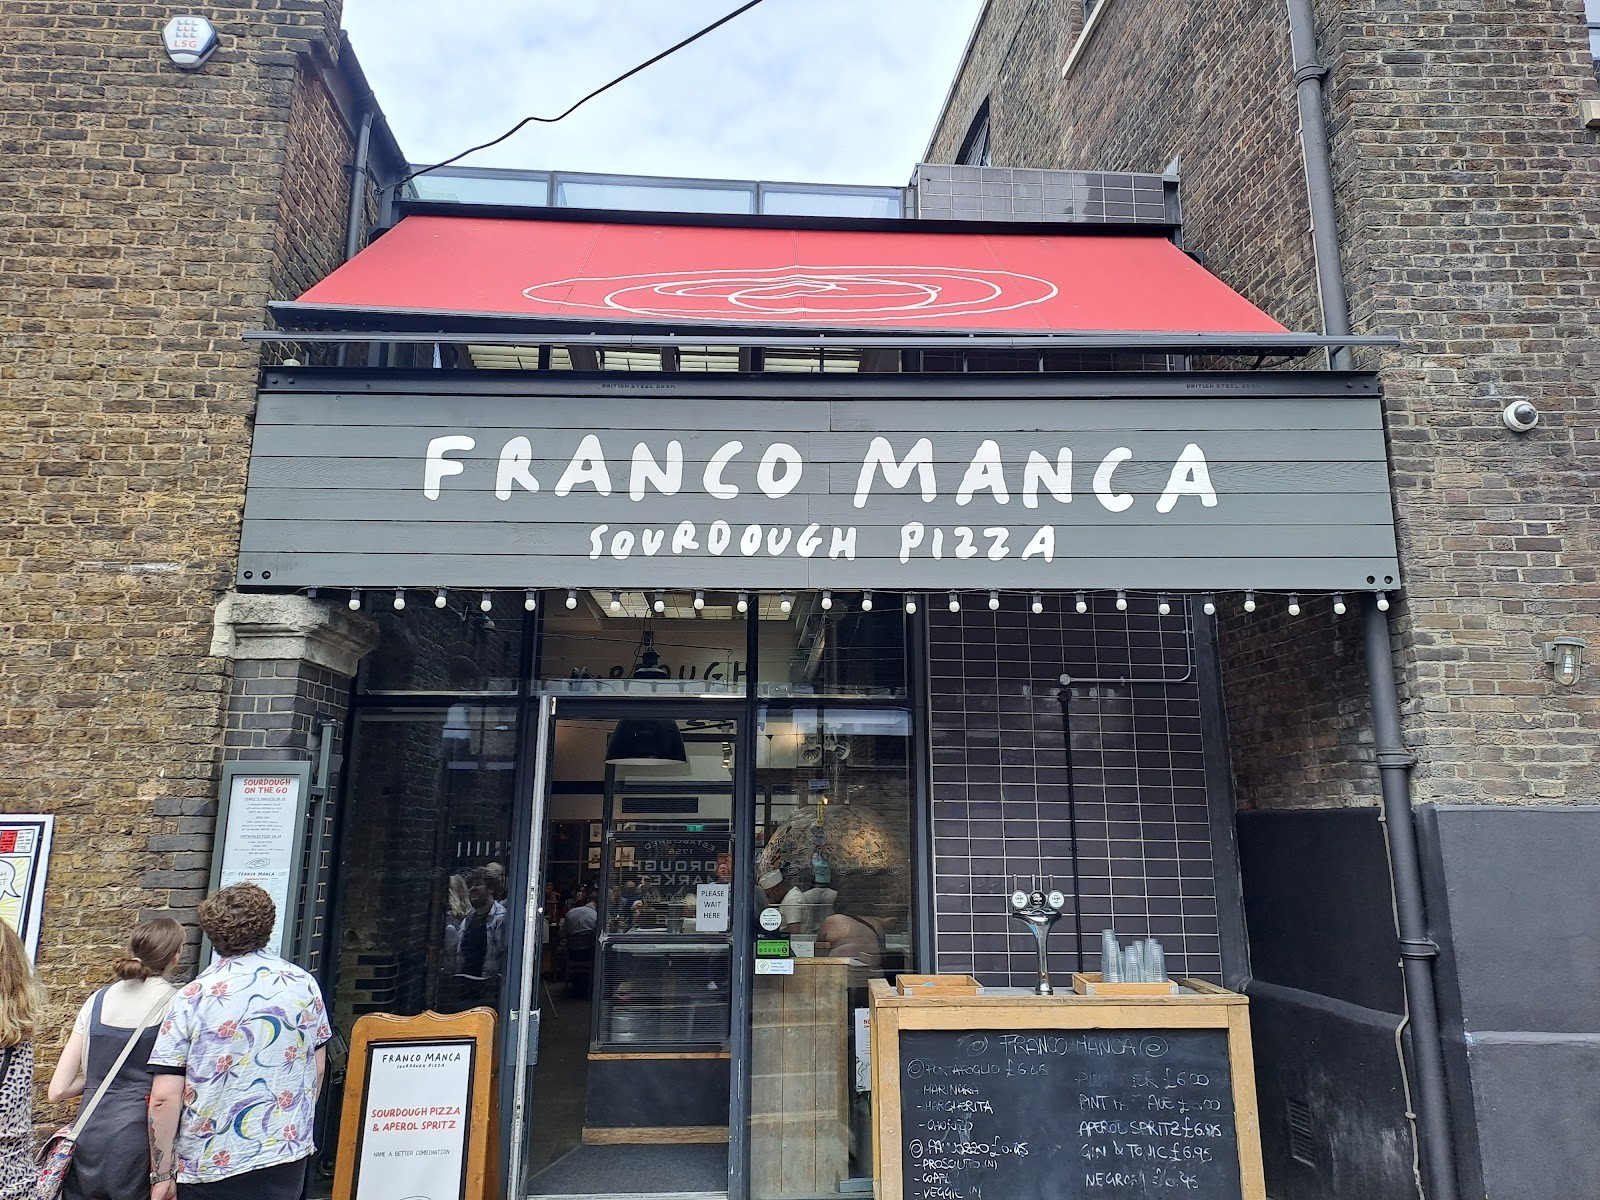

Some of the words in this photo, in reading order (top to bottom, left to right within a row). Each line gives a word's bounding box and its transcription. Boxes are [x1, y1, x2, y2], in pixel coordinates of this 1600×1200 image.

[174, 40, 197, 48] LSG
[423, 434, 803, 502] FRANCO
[853, 436, 1218, 513] MANCA
[589, 520, 857, 561] SOURDOUGH
[900, 521, 1056, 564] PIZZA
[243, 778, 291, 786] SOURDOUGH
[999, 1034, 1068, 1056] FRANCO
[1076, 1035, 1136, 1056] MANCA
[382, 1054, 421, 1064] FRANCO
[424, 1052, 461, 1063] MANCA
[1079, 1093, 1109, 1111] PINT
[371, 1107, 428, 1118] SOURDOUGH
[429, 1106, 461, 1115] PIZZA
[372, 1123, 380, 1131] &
[382, 1121, 419, 1131] APEROL
[421, 1120, 456, 1130] SPRITZ
[1078, 1119, 1128, 1137] APEROL
[1130, 1120, 1182, 1137] SPRITZ
[1081, 1143, 1106, 1160] GIN
